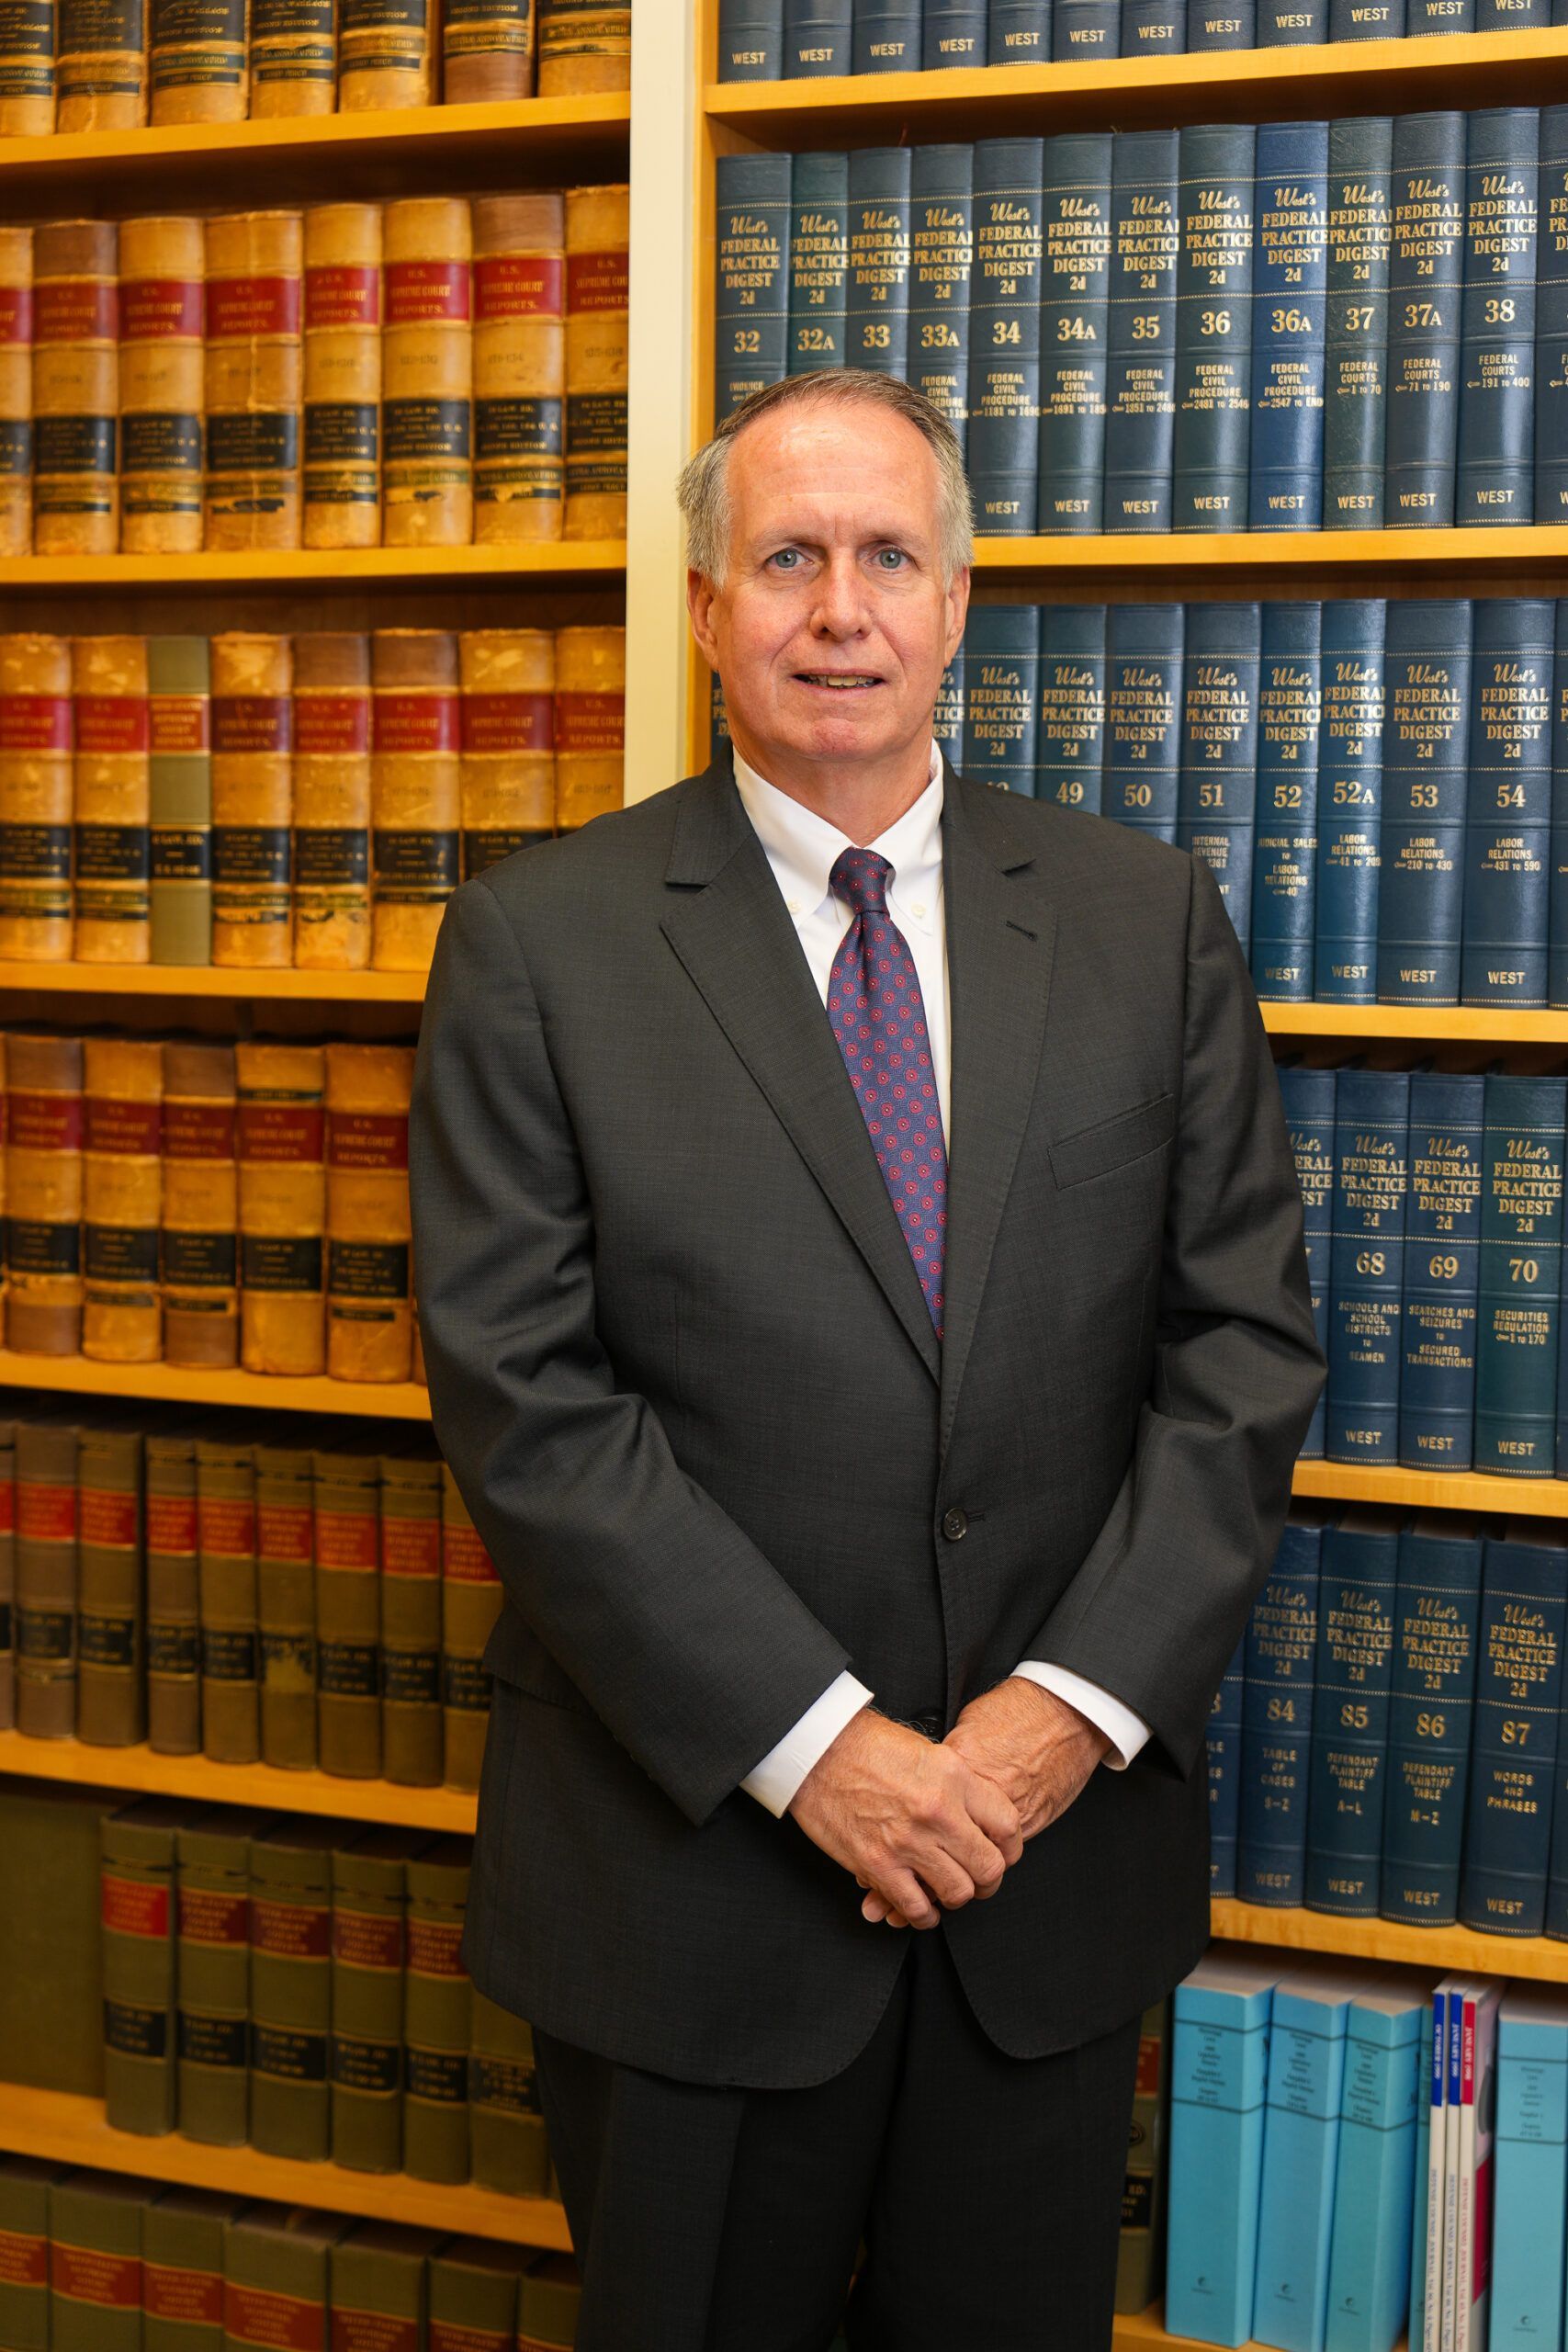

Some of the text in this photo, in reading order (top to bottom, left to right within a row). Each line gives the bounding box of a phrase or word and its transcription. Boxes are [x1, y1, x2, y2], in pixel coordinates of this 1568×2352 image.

[1427, 2, 1464, 16] WEST
[1276, 15, 1313, 28] WEST
[1005, 32, 1040, 45] WEST
[1139, 26, 1174, 39] WEST
[732, 51, 765, 64] WEST
[1408, 179, 1450, 198] West's
[1482, 176, 1525, 196] West's
[1199, 191, 1239, 209] West's
[1275, 188, 1316, 207] West's
[1396, 203, 1462, 220] FEDERAL
[1470, 200, 1537, 217] FEDERAL
[1187, 215, 1252, 231] FEDERAL
[1262, 210, 1329, 227] FEDERAL
[1394, 223, 1461, 239] PRACTICE
[1468, 220, 1537, 235] PRACTICE
[1186, 233, 1252, 248] PRACTICE
[1261, 230, 1329, 246] PRACTICE
[1401, 242, 1454, 257] DIGEST
[1474, 238, 1529, 254] DIGEST
[1191, 252, 1246, 267] DIGEST
[1268, 248, 1321, 265] DIGEST
[1492, 257, 1508, 271] 2d
[1285, 268, 1302, 282] 2d
[1417, 260, 1433, 275] 2d
[1209, 270, 1225, 285] 2d
[1404, 304, 1442, 327] 37A
[1484, 300, 1515, 322] 38
[1201, 311, 1231, 334] 36
[1271, 310, 1312, 333] 36A
[1346, 308, 1374, 331] 37
[920, 323, 959, 347] 33A
[993, 322, 1021, 345] 34
[1057, 318, 1096, 341] 34A
[1132, 316, 1159, 339] 35
[734, 330, 761, 353] 32
[797, 329, 835, 351] 32A
[863, 324, 890, 347] 33
[1339, 362, 1378, 372] FEDERAL
[1404, 358, 1441, 368] FEDERAL
[1479, 355, 1518, 364] FEDERAL
[1271, 364, 1310, 374] FEDERAL
[1404, 369, 1439, 380] COURTS
[1482, 366, 1515, 375] COURTS
[1278, 375, 1302, 384] CIVIL
[1341, 373, 1377, 383] COURTS
[1482, 378, 1498, 388] 191
[1513, 377, 1529, 388] 400
[1265, 386, 1317, 396] PROCEDURE
[1352, 385, 1356, 394] 1
[1370, 385, 1382, 394] 70
[1408, 382, 1419, 391] 71
[1433, 381, 1450, 391] 190
[1270, 398, 1291, 408] 2547
[1306, 397, 1324, 408] END
[1194, 496, 1230, 509] WEST
[1400, 493, 1436, 506] WEST
[1477, 491, 1514, 503] WEST
[1055, 501, 1089, 512] WEST
[1123, 501, 1158, 514] WEST
[1122, 668, 1162, 686] West's
[1407, 665, 1449, 684] West's
[1494, 664, 1536, 684] West's
[1111, 691, 1173, 706] FEDERAL
[1394, 688, 1461, 703] FEDERAL
[1482, 688, 1549, 703] FEDERAL
[1110, 709, 1173, 724] PRACTICE
[1393, 707, 1461, 721] PRACTICE
[1481, 707, 1548, 720] PRACTICE
[1115, 727, 1167, 741] DIGEST
[1400, 725, 1453, 739] DIGEST
[1487, 725, 1541, 739] DIGEST
[1131, 745, 1146, 759] 2d
[1416, 743, 1434, 758] 2d
[1505, 743, 1521, 758] 2d
[1057, 783, 1084, 804] 49
[1124, 785, 1151, 807] 50
[1199, 785, 1224, 807] 51
[1274, 786, 1302, 808] 52
[1334, 782, 1375, 804] 52A
[1410, 786, 1438, 808] 53
[1496, 786, 1526, 808] 54
[1410, 838, 1436, 848] LABOR
[1496, 838, 1522, 848] LABOR
[1401, 849, 1445, 859] RELATIONS
[1488, 850, 1532, 859] RELATIONS
[1406, 861, 1422, 870] 210
[1437, 860, 1452, 870] 430
[1494, 861, 1509, 870] 431
[1524, 861, 1540, 870] 590
[1400, 970, 1437, 983] WEST
[1488, 971, 1525, 985] WEST
[1428, 1137, 1470, 1158] West's
[1507, 1139, 1550, 1159] West's
[1415, 1159, 1482, 1177] FEDERAL
[1494, 1162, 1562, 1179] FEDERAL
[1413, 1178, 1481, 1195] PRACTICE
[1493, 1180, 1562, 1198] PRACTICE
[1419, 1195, 1472, 1213] DIGEST
[1499, 1198, 1553, 1216] DIGEST
[1436, 1216, 1453, 1230] 2d
[1517, 1218, 1534, 1233] 2d
[1356, 1252, 1385, 1275] 68
[1429, 1255, 1460, 1279] 69
[1509, 1258, 1539, 1283] 70
[1495, 1310, 1549, 1322] SECURITIES
[1494, 1320, 1549, 1333] REGULATION
[1510, 1334, 1515, 1343] 1
[1529, 1334, 1546, 1345] 170
[1419, 1345, 1461, 1357] SECURED
[1407, 1353, 1472, 1368] TRANSACTIONS
[1346, 1430, 1382, 1444] WEST
[1418, 1436, 1453, 1451] WEST
[1498, 1442, 1535, 1455] WEST
[1505, 1604, 1544, 1627] West's
[1490, 1625, 1557, 1647] FEDERAL
[1489, 1642, 1557, 1665] PRACTICE
[1494, 1661, 1548, 1682] DIGEST
[1510, 1682, 1527, 1697] 2d
[1267, 1699, 1294, 1722] 84
[1341, 1705, 1368, 1728] 85
[1416, 1713, 1445, 1738] 86
[1501, 1721, 1529, 1746] 87
[1494, 1770, 1534, 1786] WORDS
[1505, 1787, 1524, 1797] AND
[1487, 1796, 1538, 1815] PHRASES
[1404, 1890, 1439, 1905] WEST
[1487, 1898, 1524, 1915] WEST
